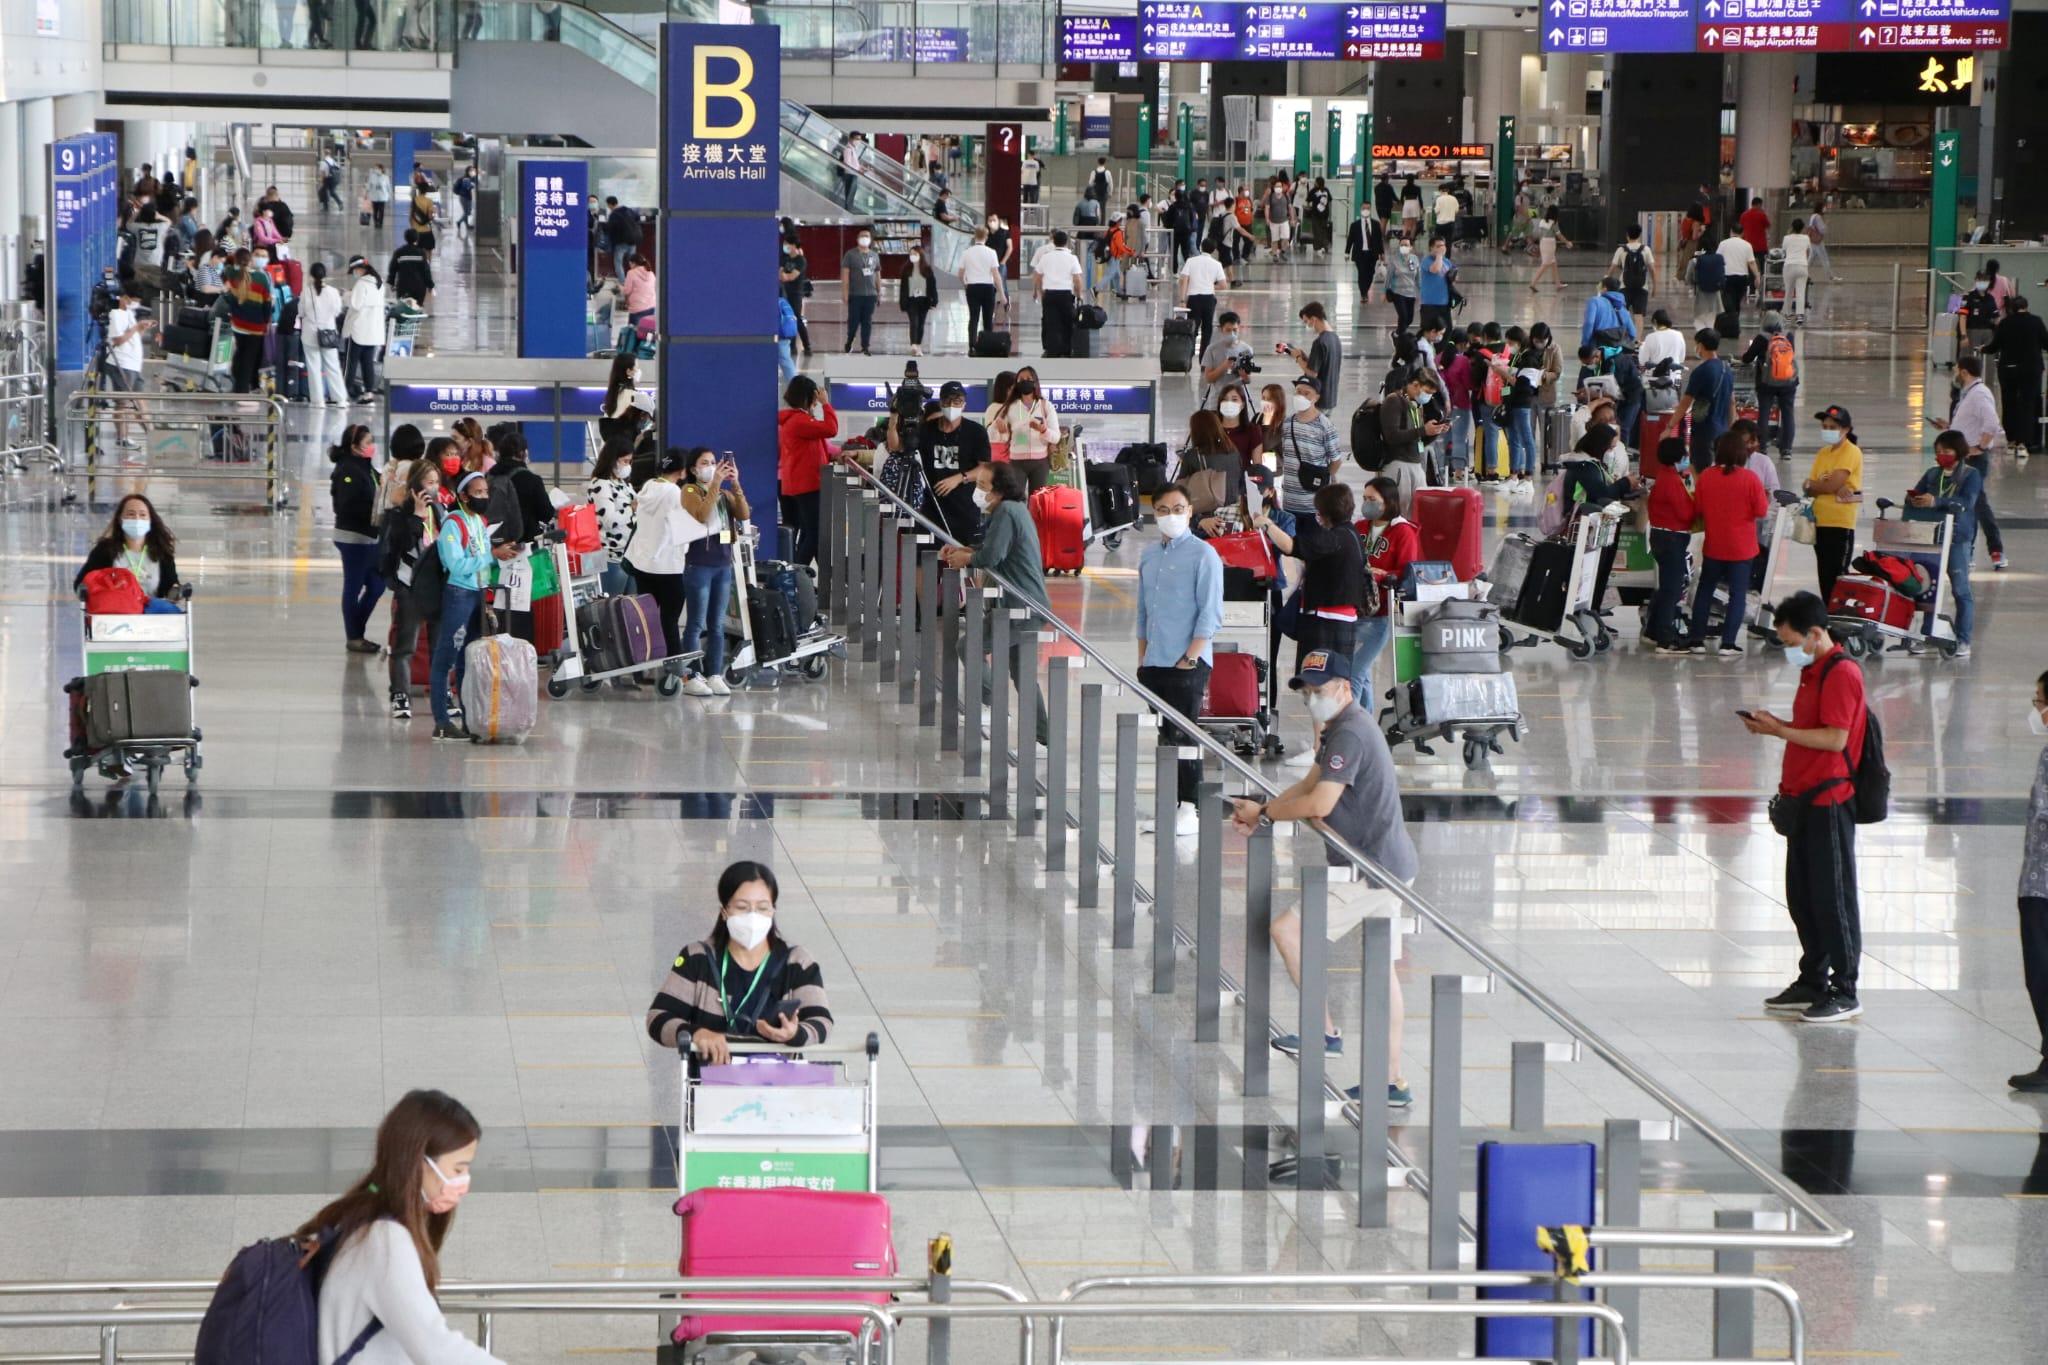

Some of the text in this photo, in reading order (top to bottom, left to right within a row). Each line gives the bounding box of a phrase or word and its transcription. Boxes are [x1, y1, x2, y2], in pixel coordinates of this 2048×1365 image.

[1191, 5, 1203, 18] A
[1298, 6, 1307, 20] 4
[1590, 9, 1688, 19] Mainland/Macao Transport
[1746, 9, 1812, 17] Tour/Hotel Coach
[1901, 8, 1999, 18] Light Goods Vehicle Area
[1101, 18, 1111, 30] A
[1743, 38, 1817, 47] Regal Airport Hotel
[1900, 37, 1972, 45] Customer Service
[692, 44, 757, 139] B
[682, 143, 768, 164] 接機大堂
[1372, 144, 1441, 158] GRAB & GO
[61, 148, 75, 171] 9
[682, 165, 767, 180] Arrivals Hall
[534, 191, 579, 206] 接待區
[534, 206, 567, 218] Group
[534, 216, 570, 228] Pick-up
[534, 227, 558, 237] Area
[437, 388, 508, 401] 團體接待區
[429, 401, 516, 412] Group pick-up area
[1061, 401, 1092, 411] pick-up
[1441, 628, 1487, 648] PINK
